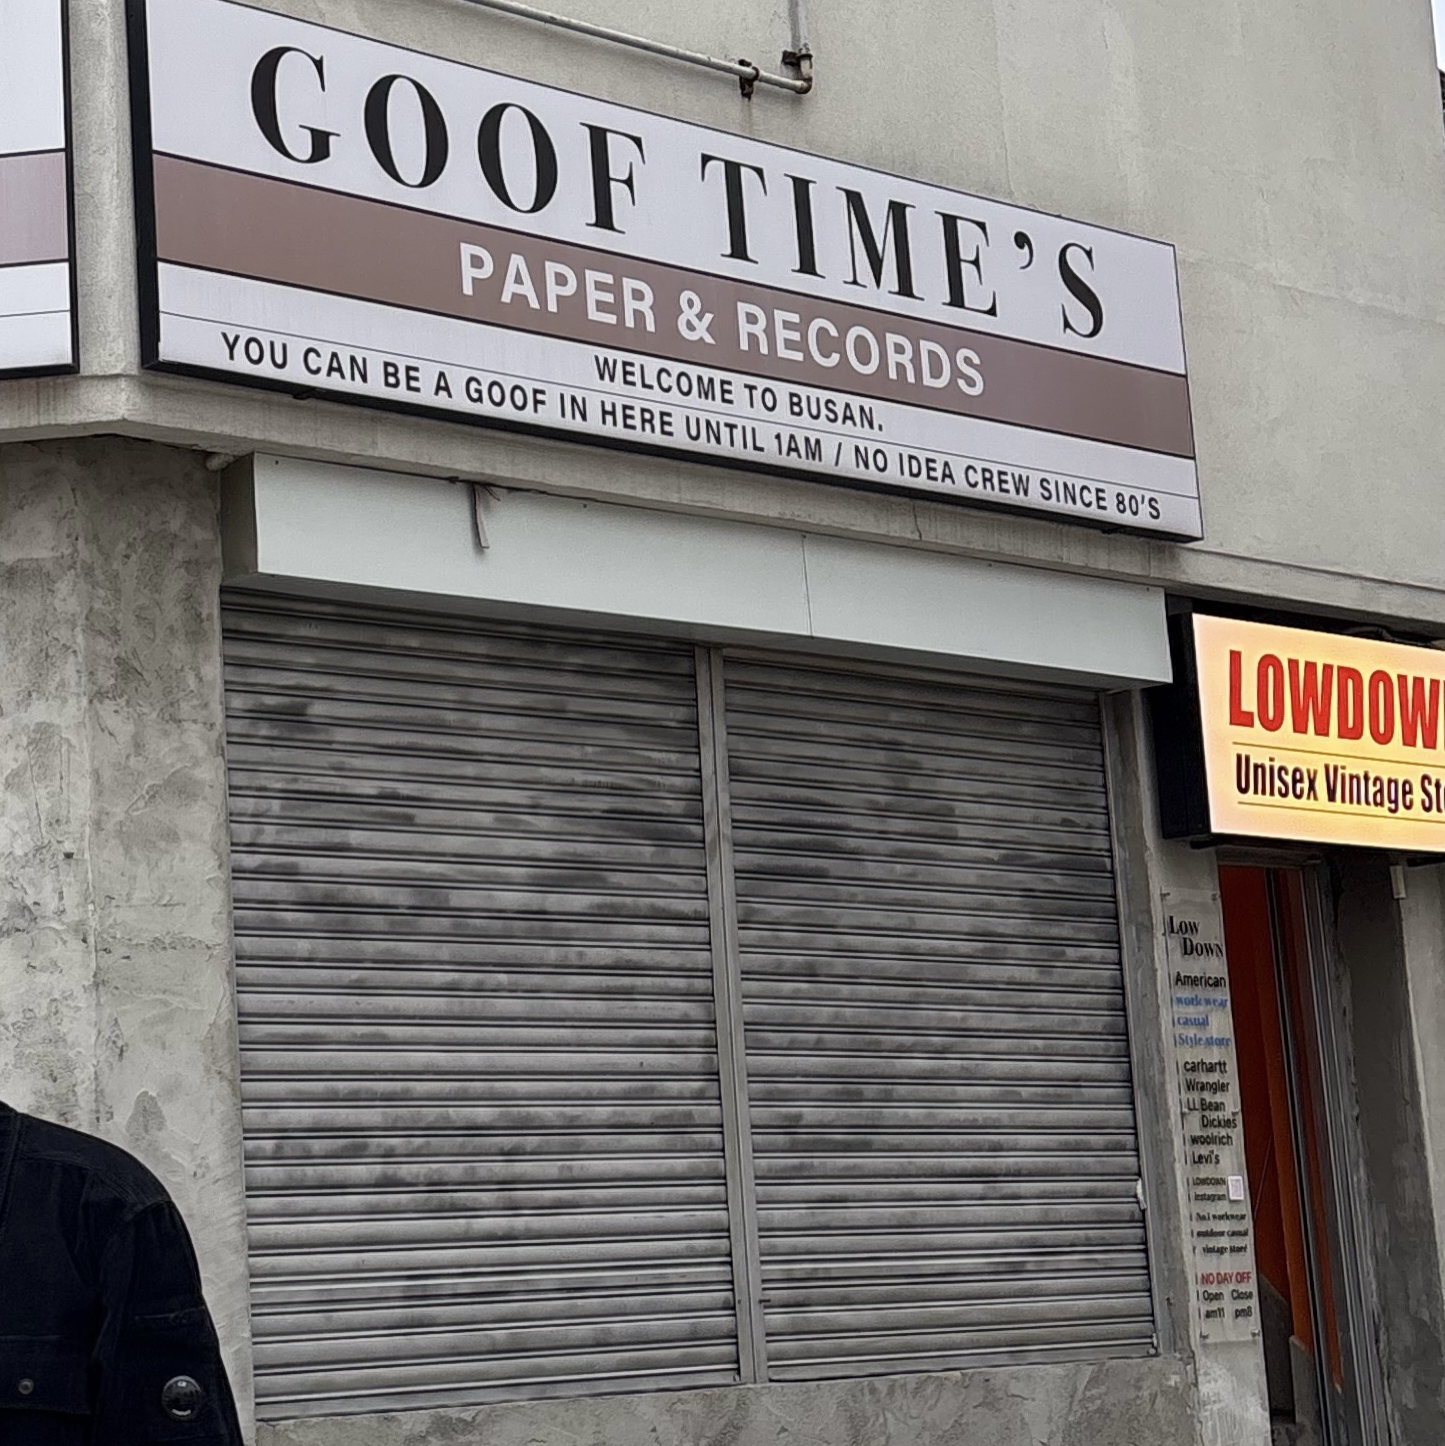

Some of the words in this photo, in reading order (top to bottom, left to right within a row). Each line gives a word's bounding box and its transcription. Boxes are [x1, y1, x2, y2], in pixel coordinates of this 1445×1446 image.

[250, 45, 646, 235] GOOF
[700, 152, 1105, 339] TIME’S
[458, 241, 657, 333] PAPER
[676, 290, 717, 345] &
[736, 299, 986, 397] RECORDS
[594, 354, 734, 404] WELCOME
[743, 383, 778, 413] TO
[789, 391, 884, 433] BUSAN.
[221, 331, 289, 370] YOU
[302, 346, 369, 385] CAN
[383, 362, 422, 394] BE
[433, 370, 453, 399] A
[465, 377, 548, 415] GOOF
[559, 393, 588, 422] IN
[600, 402, 675, 438] HERE
[686, 416, 765, 453] UNTIL
[774, 432, 823, 463] 1AM
[834, 442, 843, 467] /
[855, 444, 889, 474] NO
[899, 454, 956, 485] IDEA
[965, 464, 1031, 500] CREW
[1040, 476, 1109, 511] SINCE
[1116, 491, 1162, 521] 80'S
[1229, 649, 1445, 751] LOWDOW
[1236, 753, 1319, 802] Unisex
[1324, 763, 1414, 815] Vintage
[1421, 773, 1445, 814] St
[1175, 971, 1227, 988] American
[1177, 1014, 1209, 1027] casual
[1178, 1033, 1203, 1048] Style
[1184, 1058, 1227, 1074] carhartt
[1185, 1077, 1230, 1094] Wrangler
[1200, 1098, 1226, 1112] Bean
[1202, 1114, 1237, 1129] Dickies
[1190, 1132, 1233, 1146] woolrich
[1192, 1149, 1220, 1165] Levi's
[1201, 1272, 1215, 1285] NO
[1216, 1272, 1234, 1285] DAY
[1235, 1271, 1252, 1284] OFF
[1203, 1289, 1225, 1303] Open
[1231, 1288, 1254, 1301] Close
